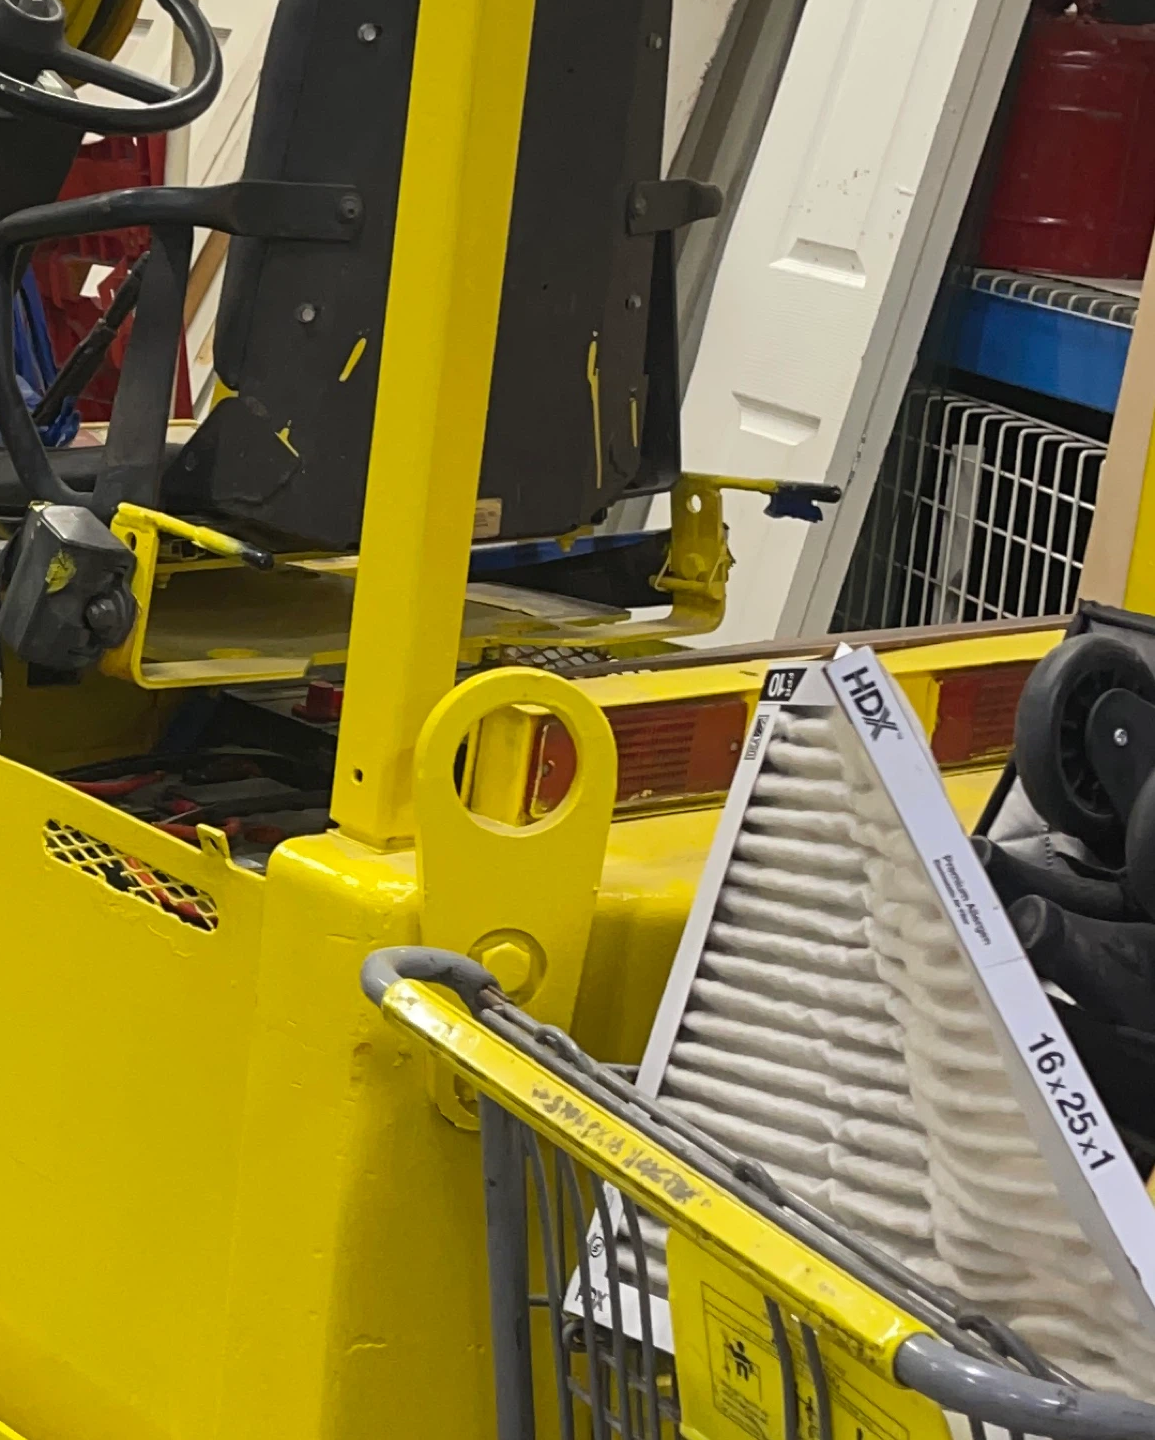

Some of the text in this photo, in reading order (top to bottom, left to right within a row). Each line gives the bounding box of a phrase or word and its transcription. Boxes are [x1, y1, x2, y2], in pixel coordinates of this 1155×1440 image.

[767, 672, 786, 698] 10
[842, 666, 900, 741] HDX
[942, 855, 969, 901] Premium
[965, 903, 991, 945] Allergen
